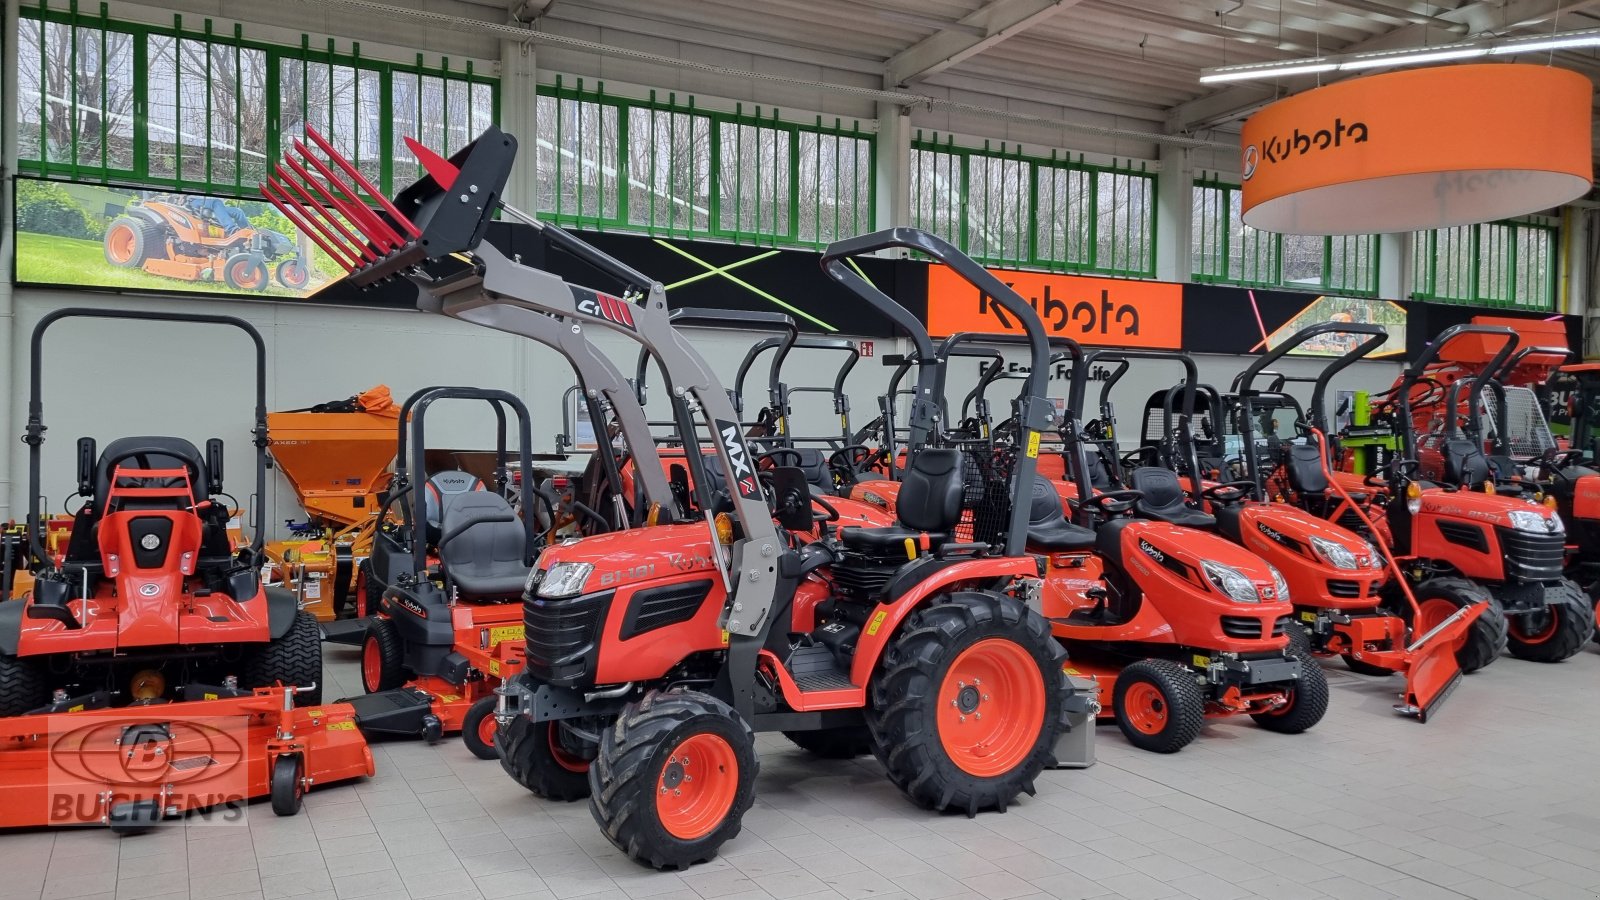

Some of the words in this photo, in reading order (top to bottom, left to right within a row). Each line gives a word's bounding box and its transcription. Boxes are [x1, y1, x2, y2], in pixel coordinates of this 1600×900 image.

[1261, 118, 1369, 164] Kubota
[577, 299, 600, 316] C1
[721, 425, 751, 479] MX
[1259, 523, 1281, 541] Kubota
[1140, 540, 1165, 562] Kubota
[404, 599, 422, 614] Kubota
